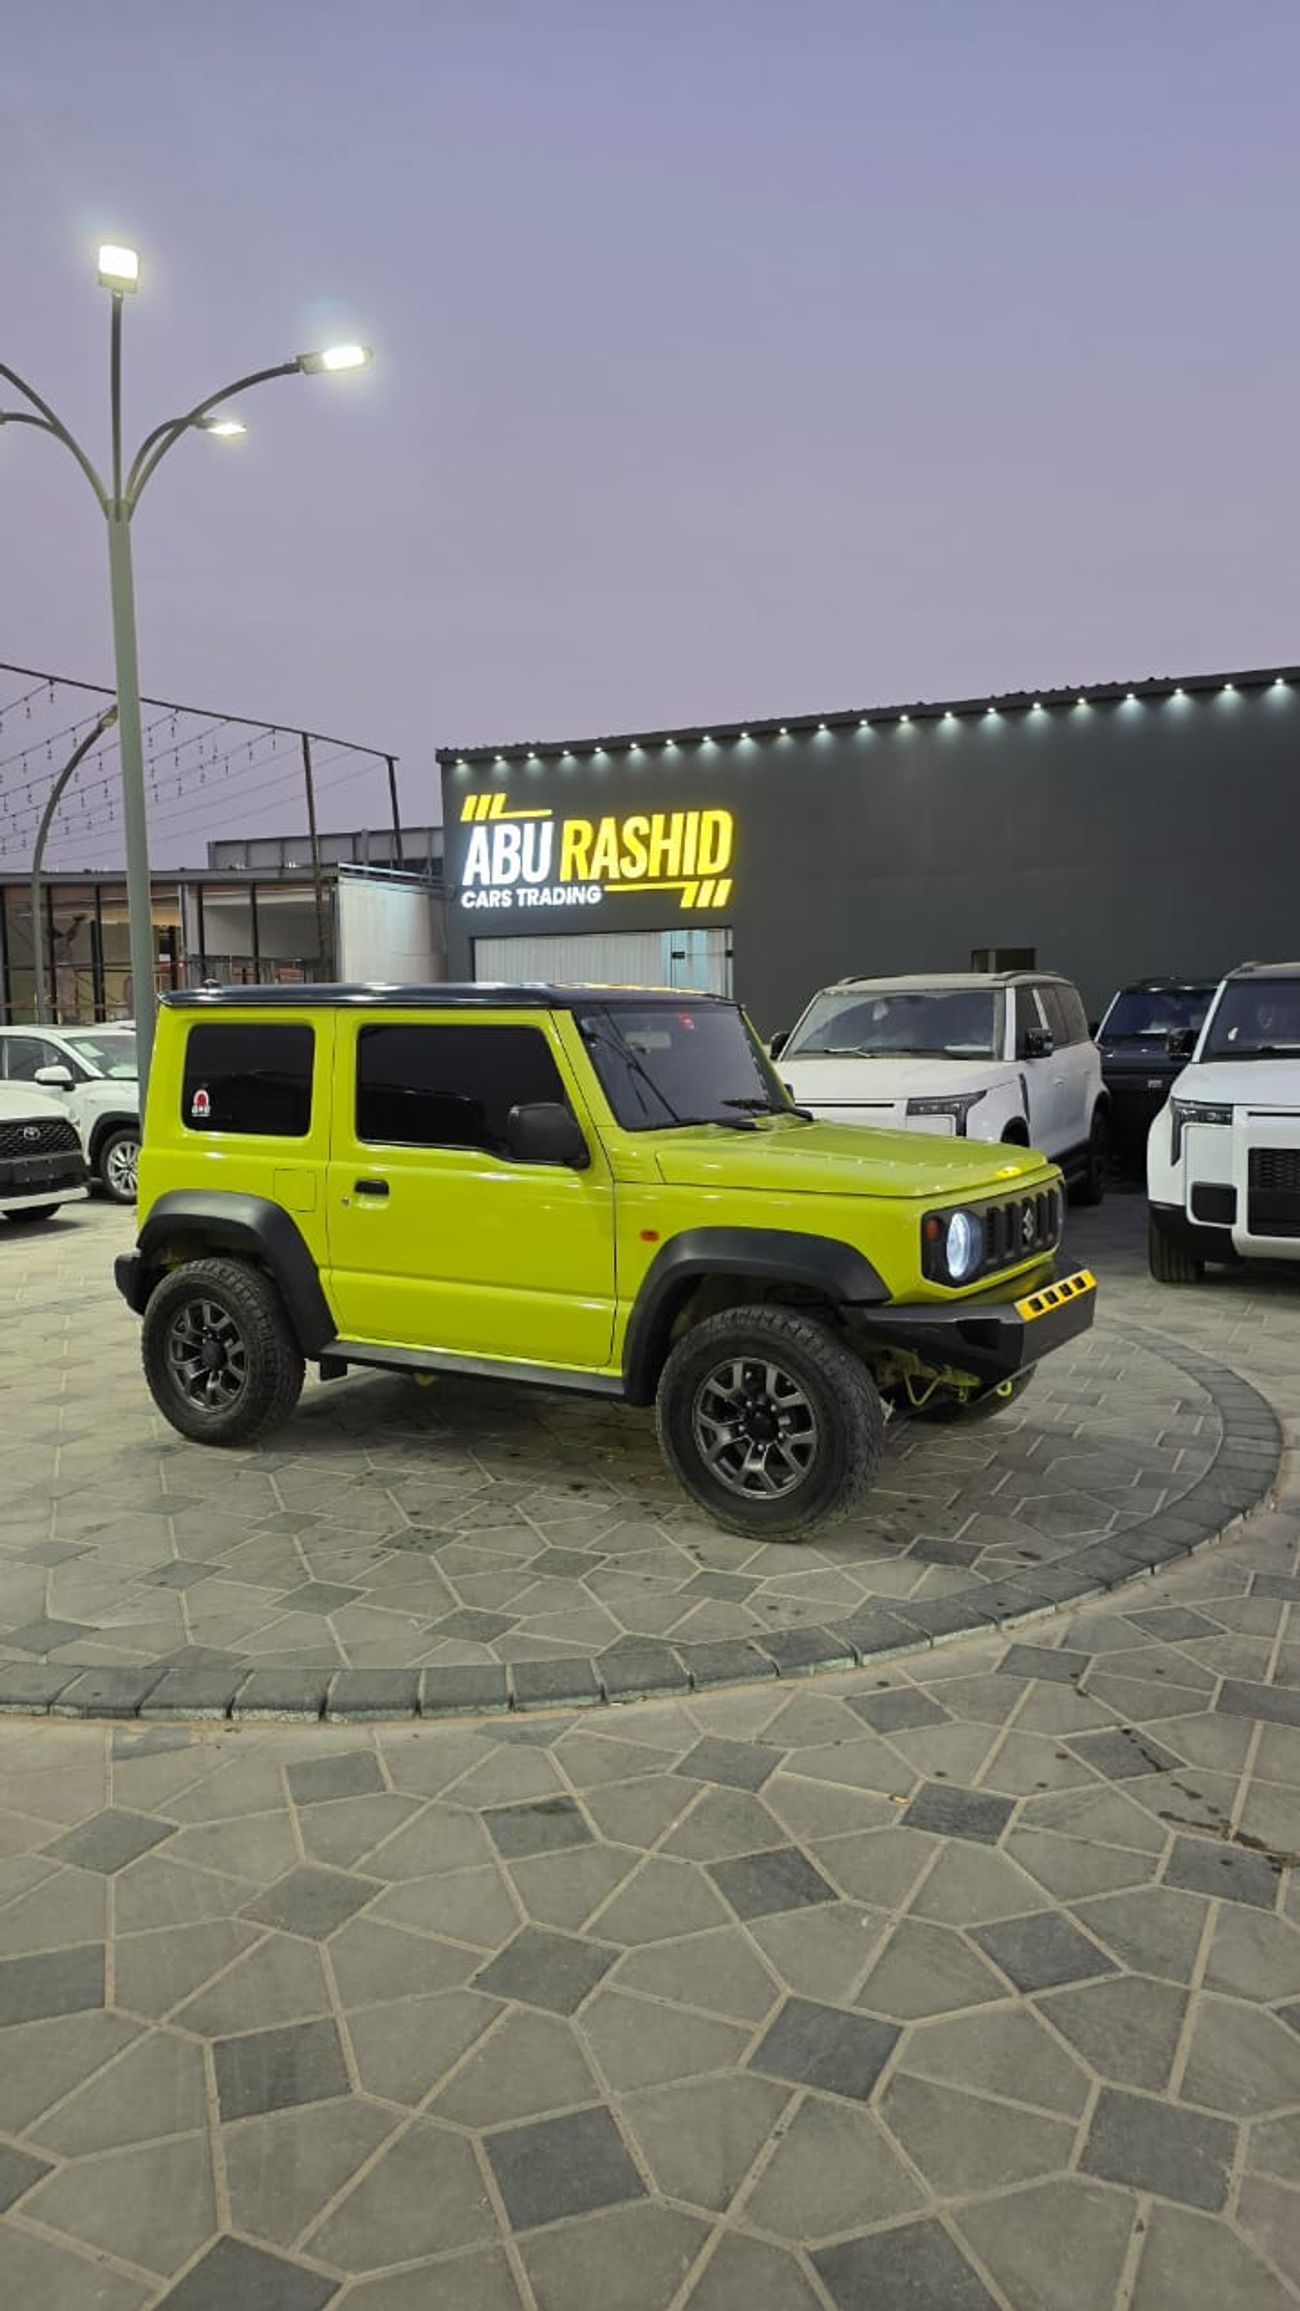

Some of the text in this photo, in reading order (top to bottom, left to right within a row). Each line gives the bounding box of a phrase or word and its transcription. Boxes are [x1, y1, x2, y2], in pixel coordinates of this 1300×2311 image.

[462, 809, 733, 886] ABU RASHID
[461, 884, 602, 909] CARS TRADING
